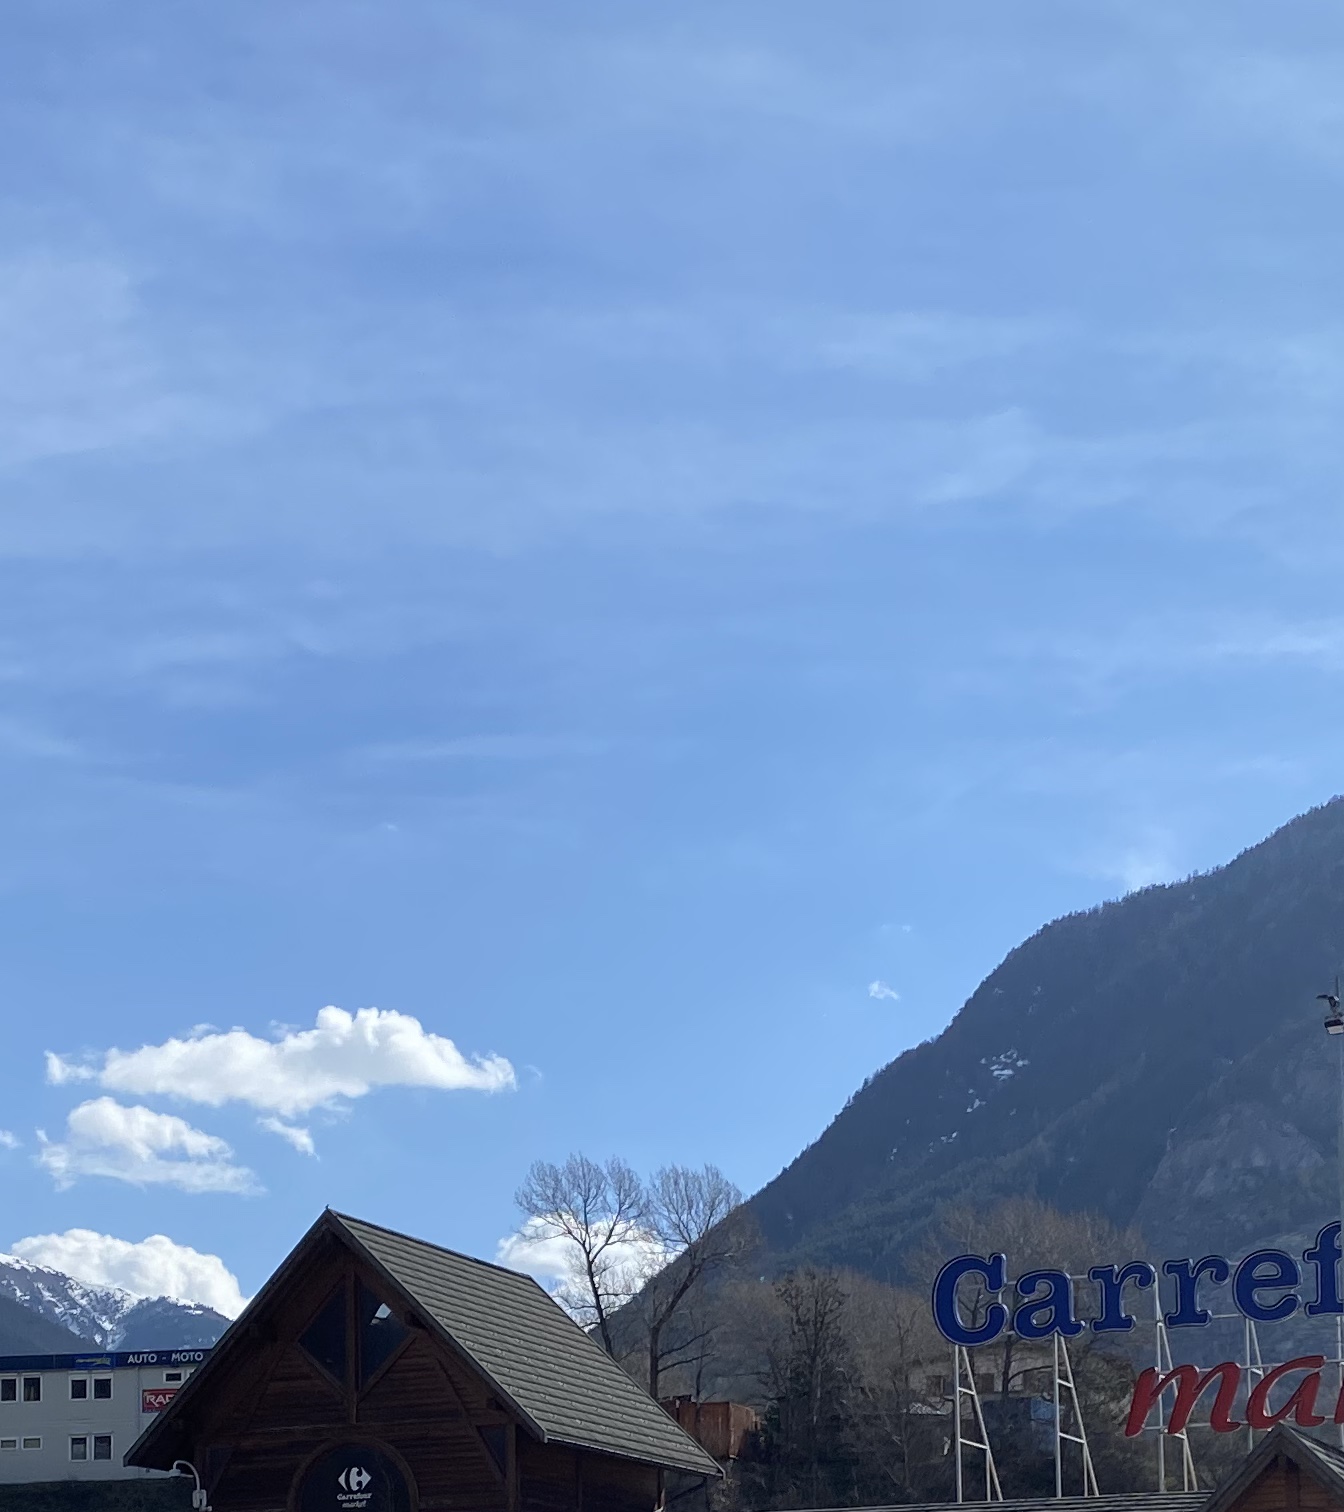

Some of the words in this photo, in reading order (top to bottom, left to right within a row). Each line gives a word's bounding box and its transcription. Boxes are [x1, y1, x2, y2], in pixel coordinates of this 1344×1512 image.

[127, 1353, 157, 1364] AUTO
[171, 1352, 204, 1362] MOTO
[337, 1493, 372, 1501] Carrefour
